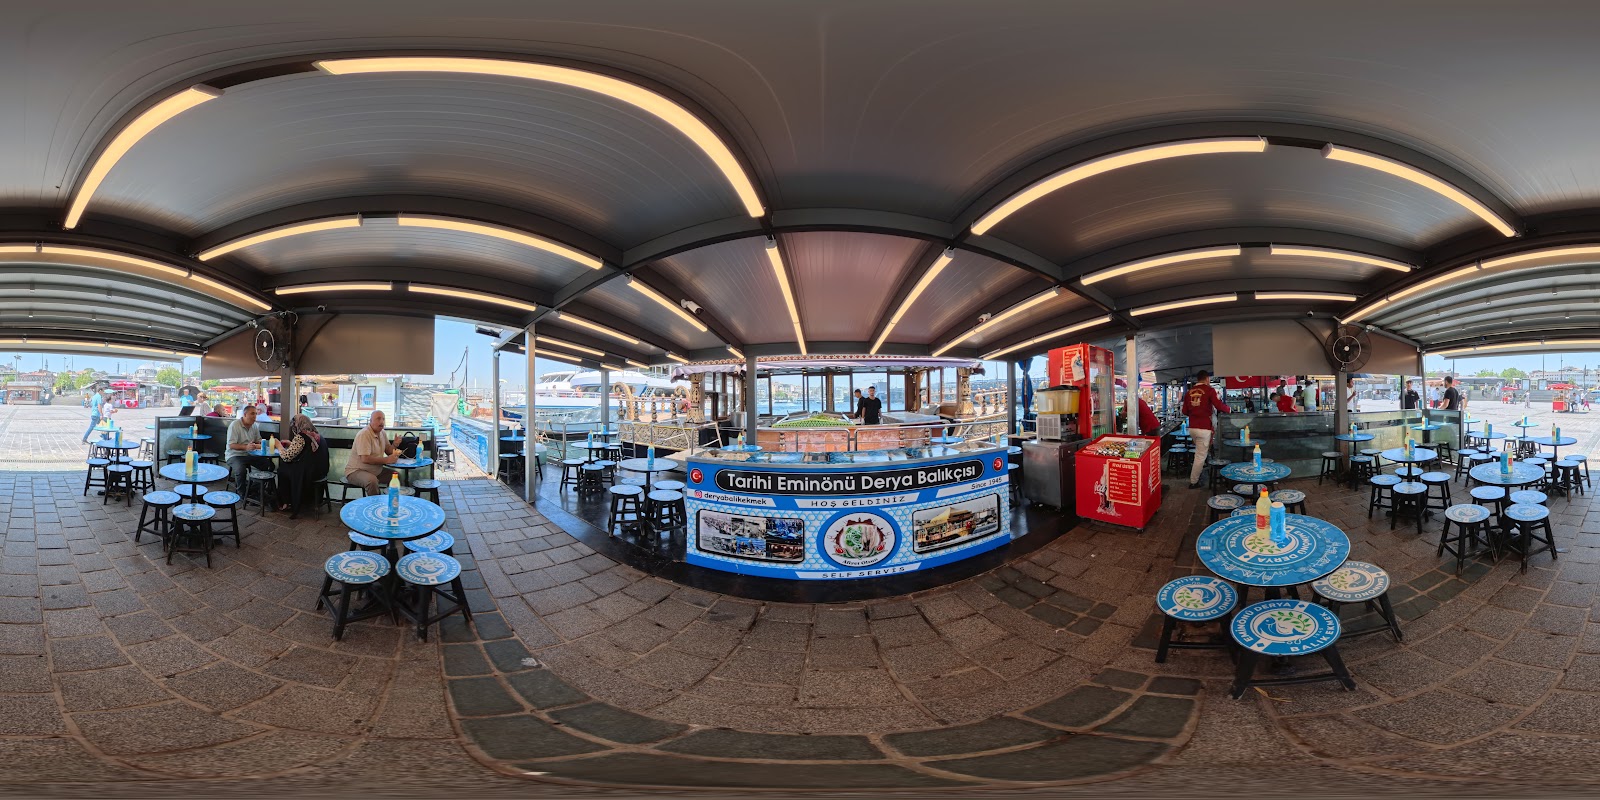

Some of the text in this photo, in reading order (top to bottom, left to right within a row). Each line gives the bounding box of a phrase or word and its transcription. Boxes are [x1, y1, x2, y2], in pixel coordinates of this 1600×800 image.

[727, 465, 976, 492] Tarihi Eminönü Derya Balıkçısı
[971, 477, 1003, 490] Since 1945
[704, 492, 767, 505] deryabalikekmek
[811, 500, 837, 508] HOŞ
[1257, 552, 1299, 563] DERYA
[1160, 577, 1201, 601] BALIK EKMEK
[1321, 586, 1351, 599] DERYA
[1183, 609, 1219, 617] DERYA
[1253, 602, 1292, 612] DERYA
[1289, 611, 1336, 653] BALIK EKMEK
